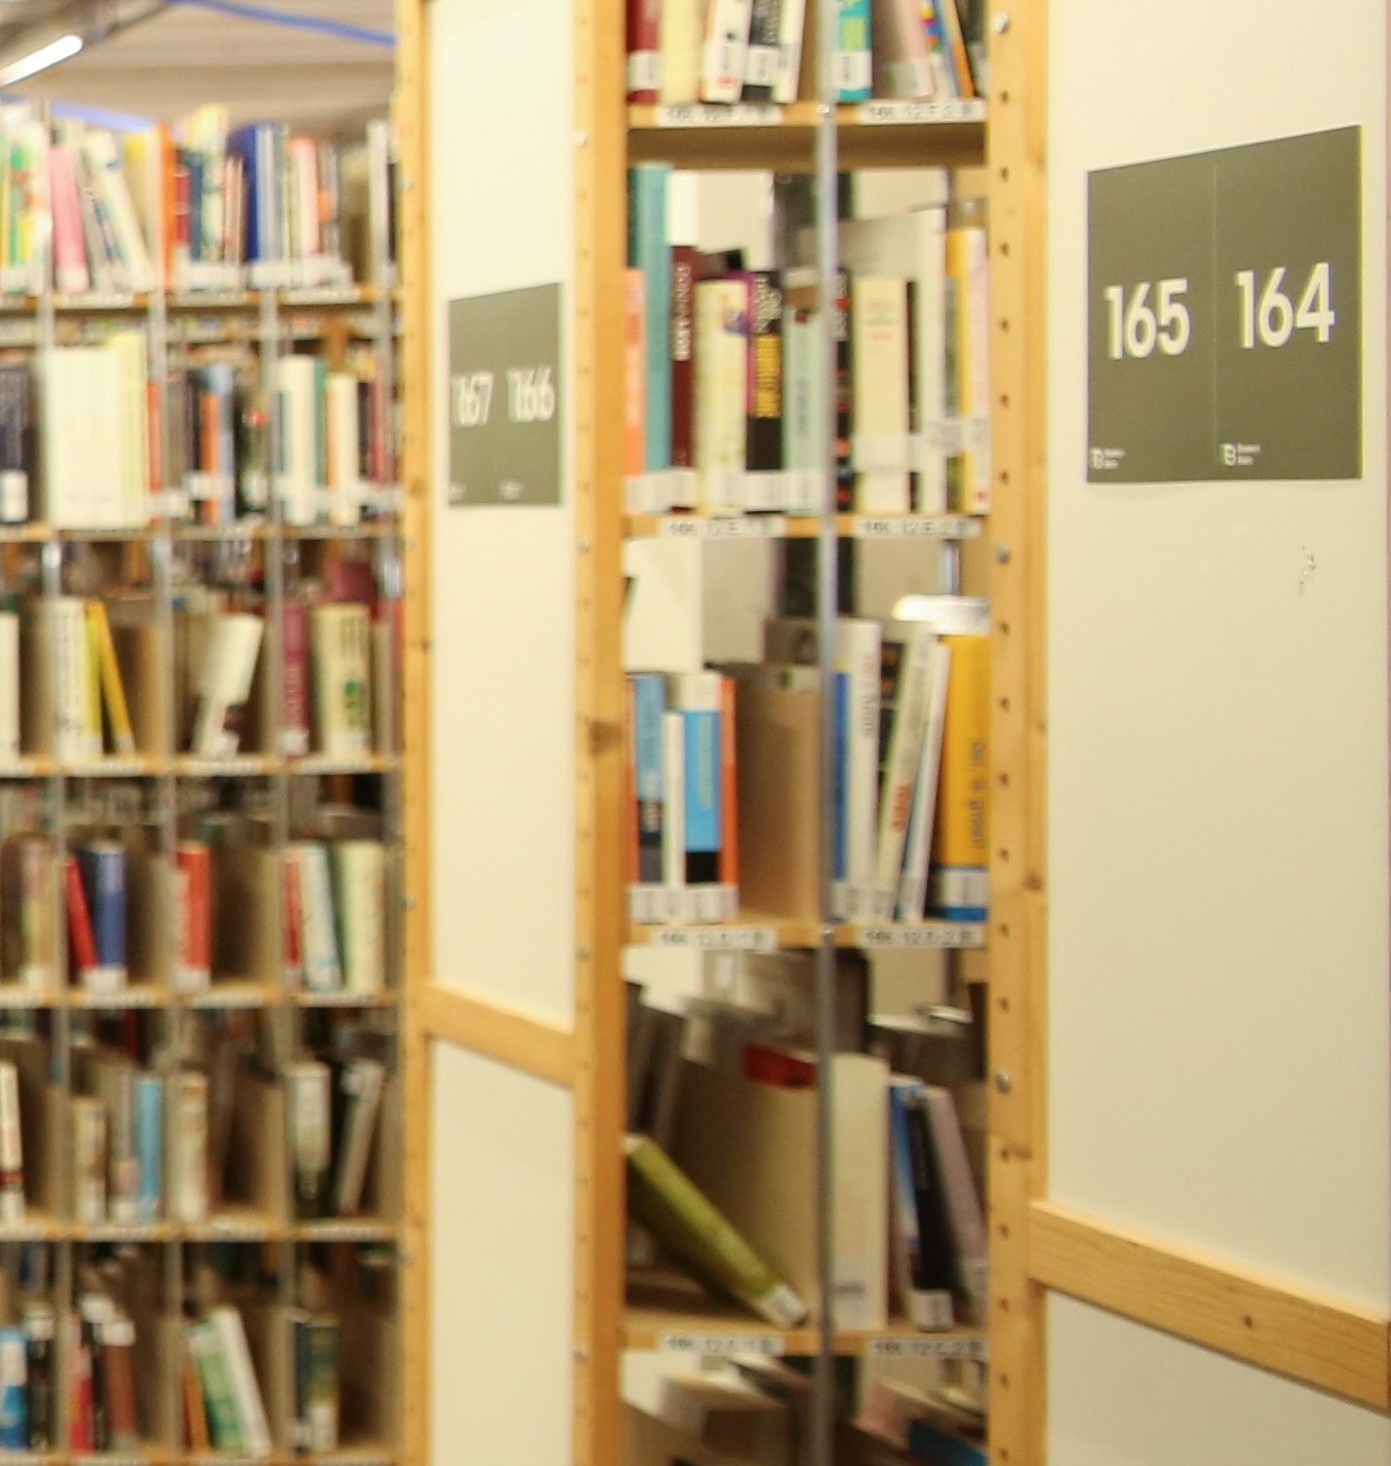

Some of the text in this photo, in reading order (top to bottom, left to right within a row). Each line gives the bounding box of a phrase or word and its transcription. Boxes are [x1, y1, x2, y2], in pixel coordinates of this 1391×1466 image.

[1104, 262, 1336, 360] 165 164
[452, 366, 556, 428] 167 166
